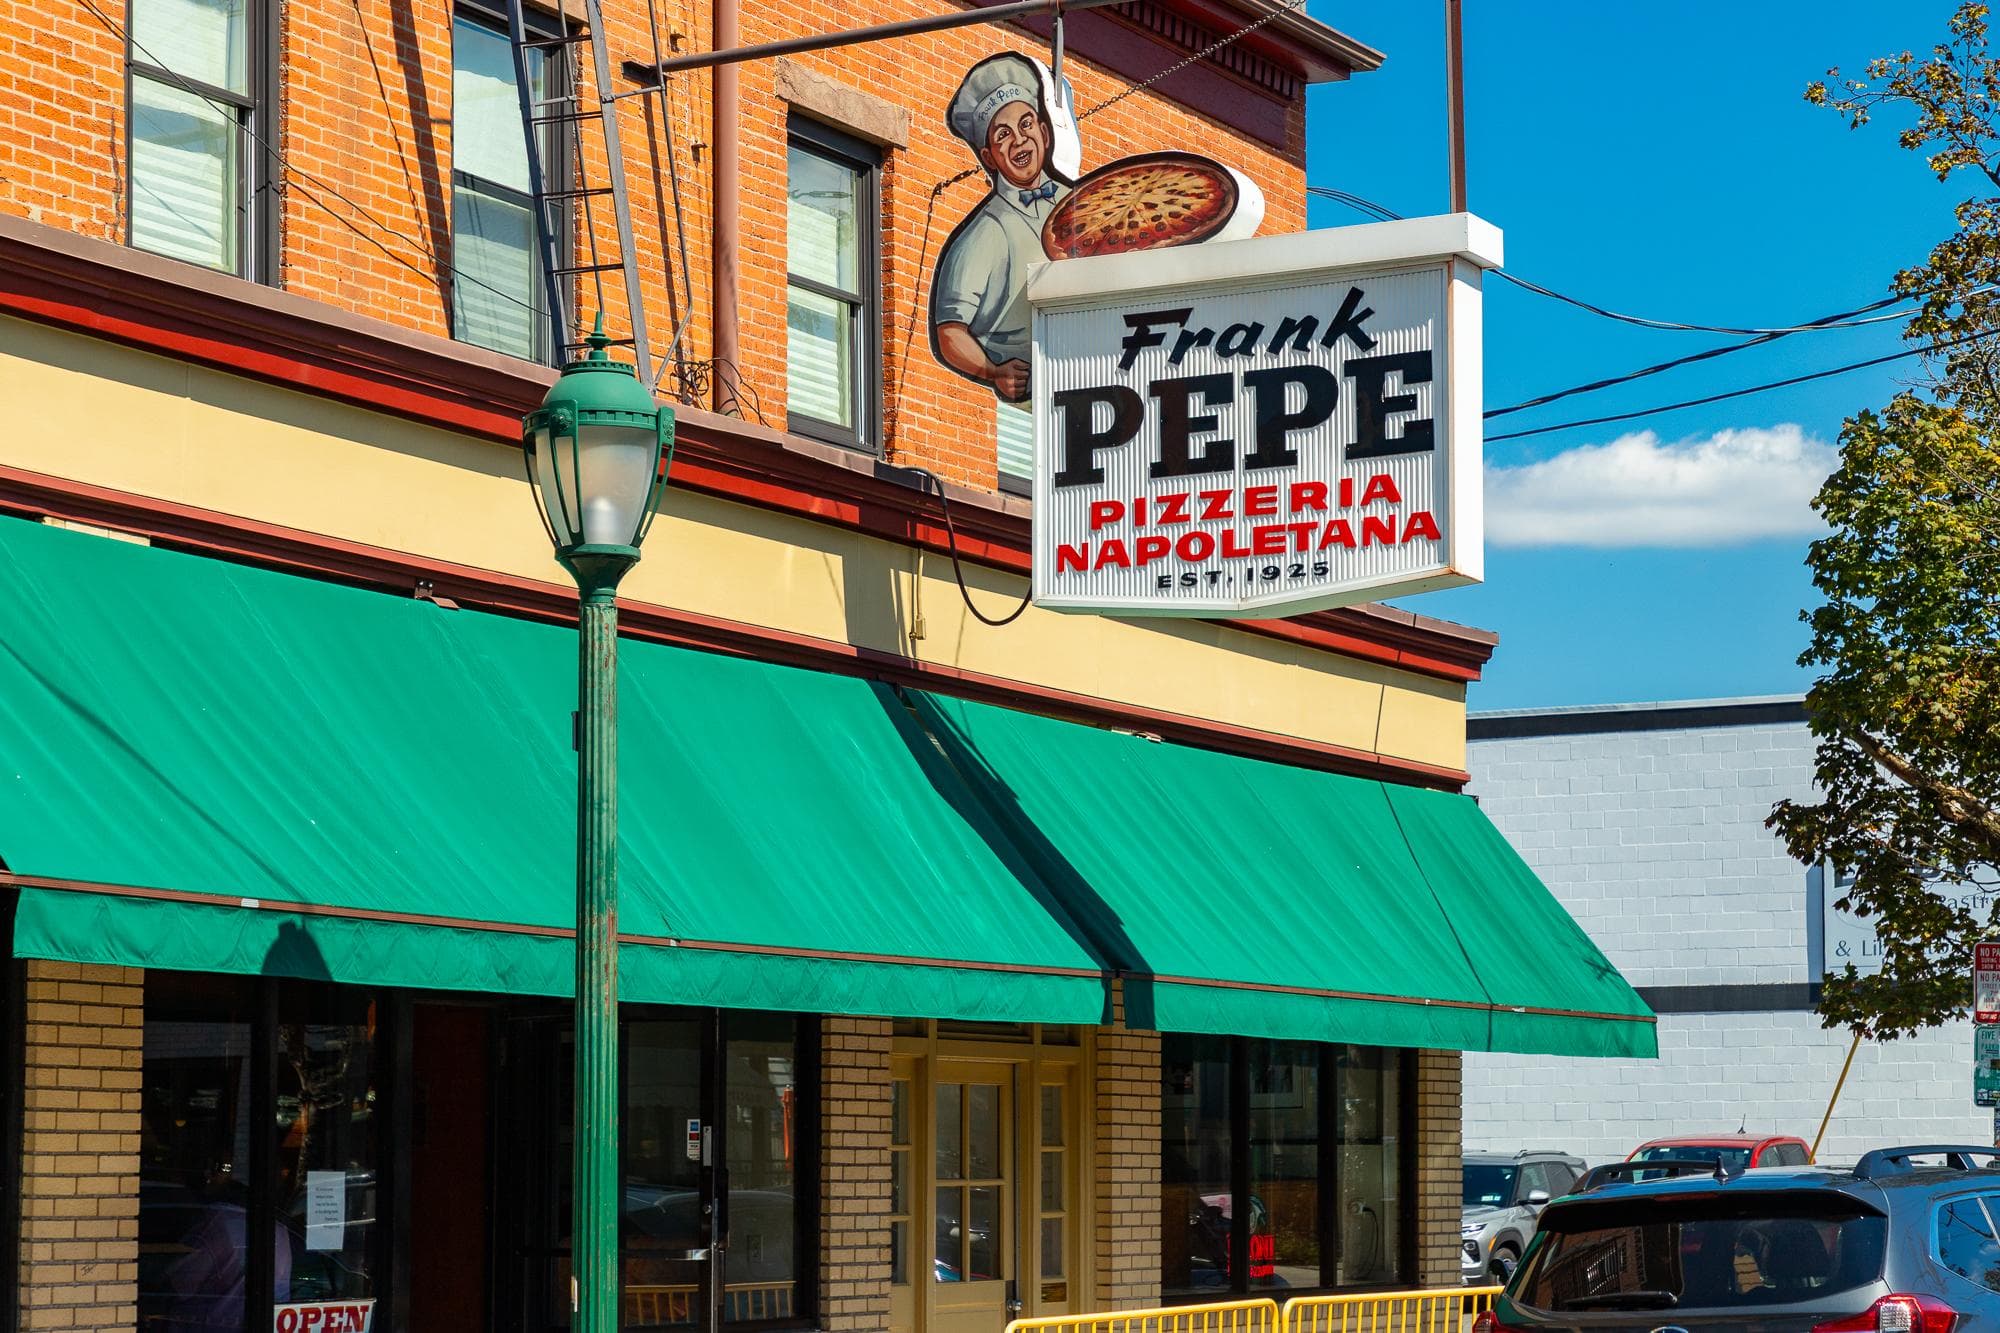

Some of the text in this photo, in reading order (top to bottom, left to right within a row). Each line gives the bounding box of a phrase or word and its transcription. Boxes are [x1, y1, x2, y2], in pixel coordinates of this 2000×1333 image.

[996, 88, 1020, 102] Pepe
[1116, 286, 1378, 371] Frank
[1054, 350, 1435, 488] PEPE
[1090, 473, 1402, 530] PIZZERIA
[1056, 511, 1441, 573] NAPOLETANA
[1157, 561, 1330, 589] EST. 1925
[1835, 939, 1852, 957] &
[1980, 947, 1990, 957] NO
[1980, 972, 1990, 982] NO
[1981, 1030, 1995, 1040] FIVE
[276, 1305, 370, 1333] OPEN
